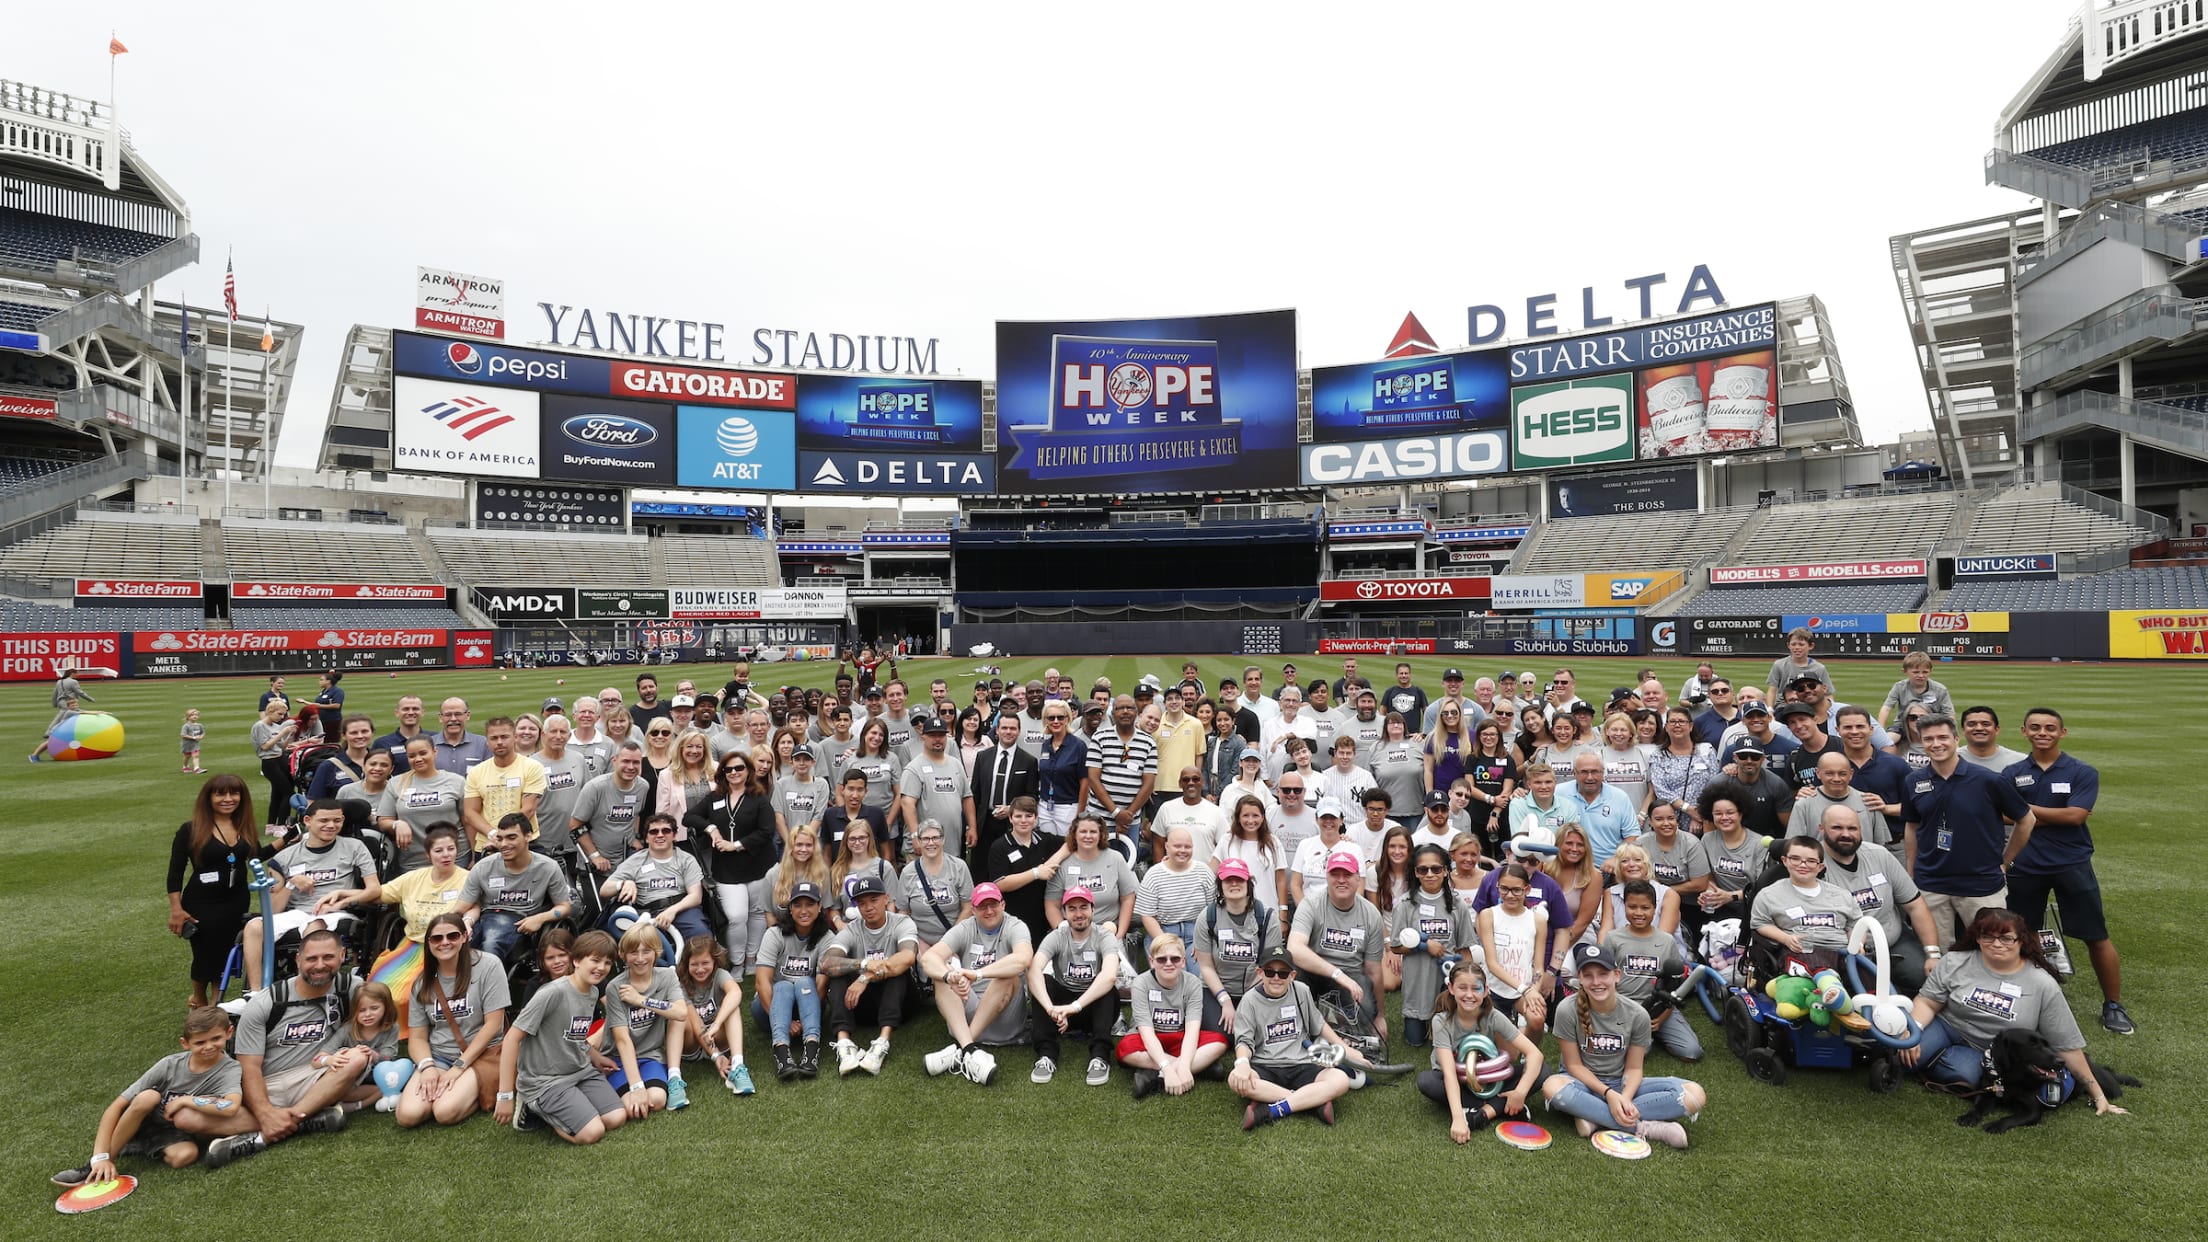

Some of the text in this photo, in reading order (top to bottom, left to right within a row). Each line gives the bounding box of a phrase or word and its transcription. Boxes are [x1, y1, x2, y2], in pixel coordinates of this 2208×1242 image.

[420, 273, 500, 295] ARMITRON
[1468, 263, 1725, 346] DELTA
[424, 311, 496, 330] ARMITRON
[1649, 308, 1775, 344] INSURANCE
[460, 325, 494, 336] WATCHES
[537, 301, 940, 374] YANKEE STADIUM
[1649, 324, 1775, 359] COMPANIES
[1089, 347, 1192, 364] 10th Anniversary
[1511, 335, 1634, 378] STARR
[488, 356, 567, 381] pepsi
[623, 368, 784, 401] GATORADE
[1062, 362, 1215, 410] HOPE
[1375, 369, 1448, 398] HOPE
[860, 391, 929, 413] HOPE
[1384, 393, 1438, 404] WEEK
[1086, 410, 1198, 426] WEEK
[1523, 404, 1622, 440] HESS
[581, 418, 638, 444] Ford
[398, 446, 536, 466] BANK OF AMERICA
[1037, 437, 1239, 468] HELPING OTHERS PERSEVERE & EXCEL
[1309, 431, 1503, 482] CASIO
[563, 454, 656, 470] BuyFordNow.com
[712, 461, 763, 481] AT&T
[857, 460, 984, 484] DELTA
[1613, 500, 1665, 511] THE BOSS
[1463, 552, 1490, 560] TOYOTA
[1717, 563, 1919, 581] MODELL'S MODELLS.com
[1959, 558, 2036, 572] UNTUCKit
[1384, 581, 1453, 596] TOYOTA
[1494, 589, 1551, 598] MERRILL
[1611, 582, 1644, 597] SAP
[675, 591, 757, 605] BUDWEISER
[784, 592, 824, 600] DANNON
[489, 596, 547, 611] AMD
[1708, 620, 1762, 629] GATORADE
[1825, 618, 1858, 629] pepsi
[2138, 617, 2175, 629] WHO
[2, 638, 116, 655] THIS BUD'S
[1454, 640, 1469, 649] 385
[1514, 640, 1629, 653] StubHub StubHub
[1707, 637, 1726, 645] METS
[1953, 637, 1970, 645] POS
[363, 652, 376, 660] BAT
[405, 651, 419, 659] POS
[1701, 645, 1733, 653] YANKEES
[3, 657, 43, 673] FOR
[155, 656, 180, 665] METS
[148, 665, 188, 673] YANKEES
[613, 807, 634, 815] HOPE
[1721, 860, 1743, 870] HOPE
[651, 877, 677, 888] HOPE
[501, 892, 527, 901] HOPE
[1421, 921, 1448, 930] HOPE
[1803, 914, 1835, 926] HOPE
[1225, 943, 1252, 953] HOPE
[788, 960, 809, 969] HOPE
[1629, 958, 1657, 968] HOPE
[1973, 990, 2013, 1010] HOPE
[1154, 1011, 1179, 1021] HOPE
[289, 1024, 322, 1036] HOPE
[1268, 1022, 1295, 1036] HOPE
